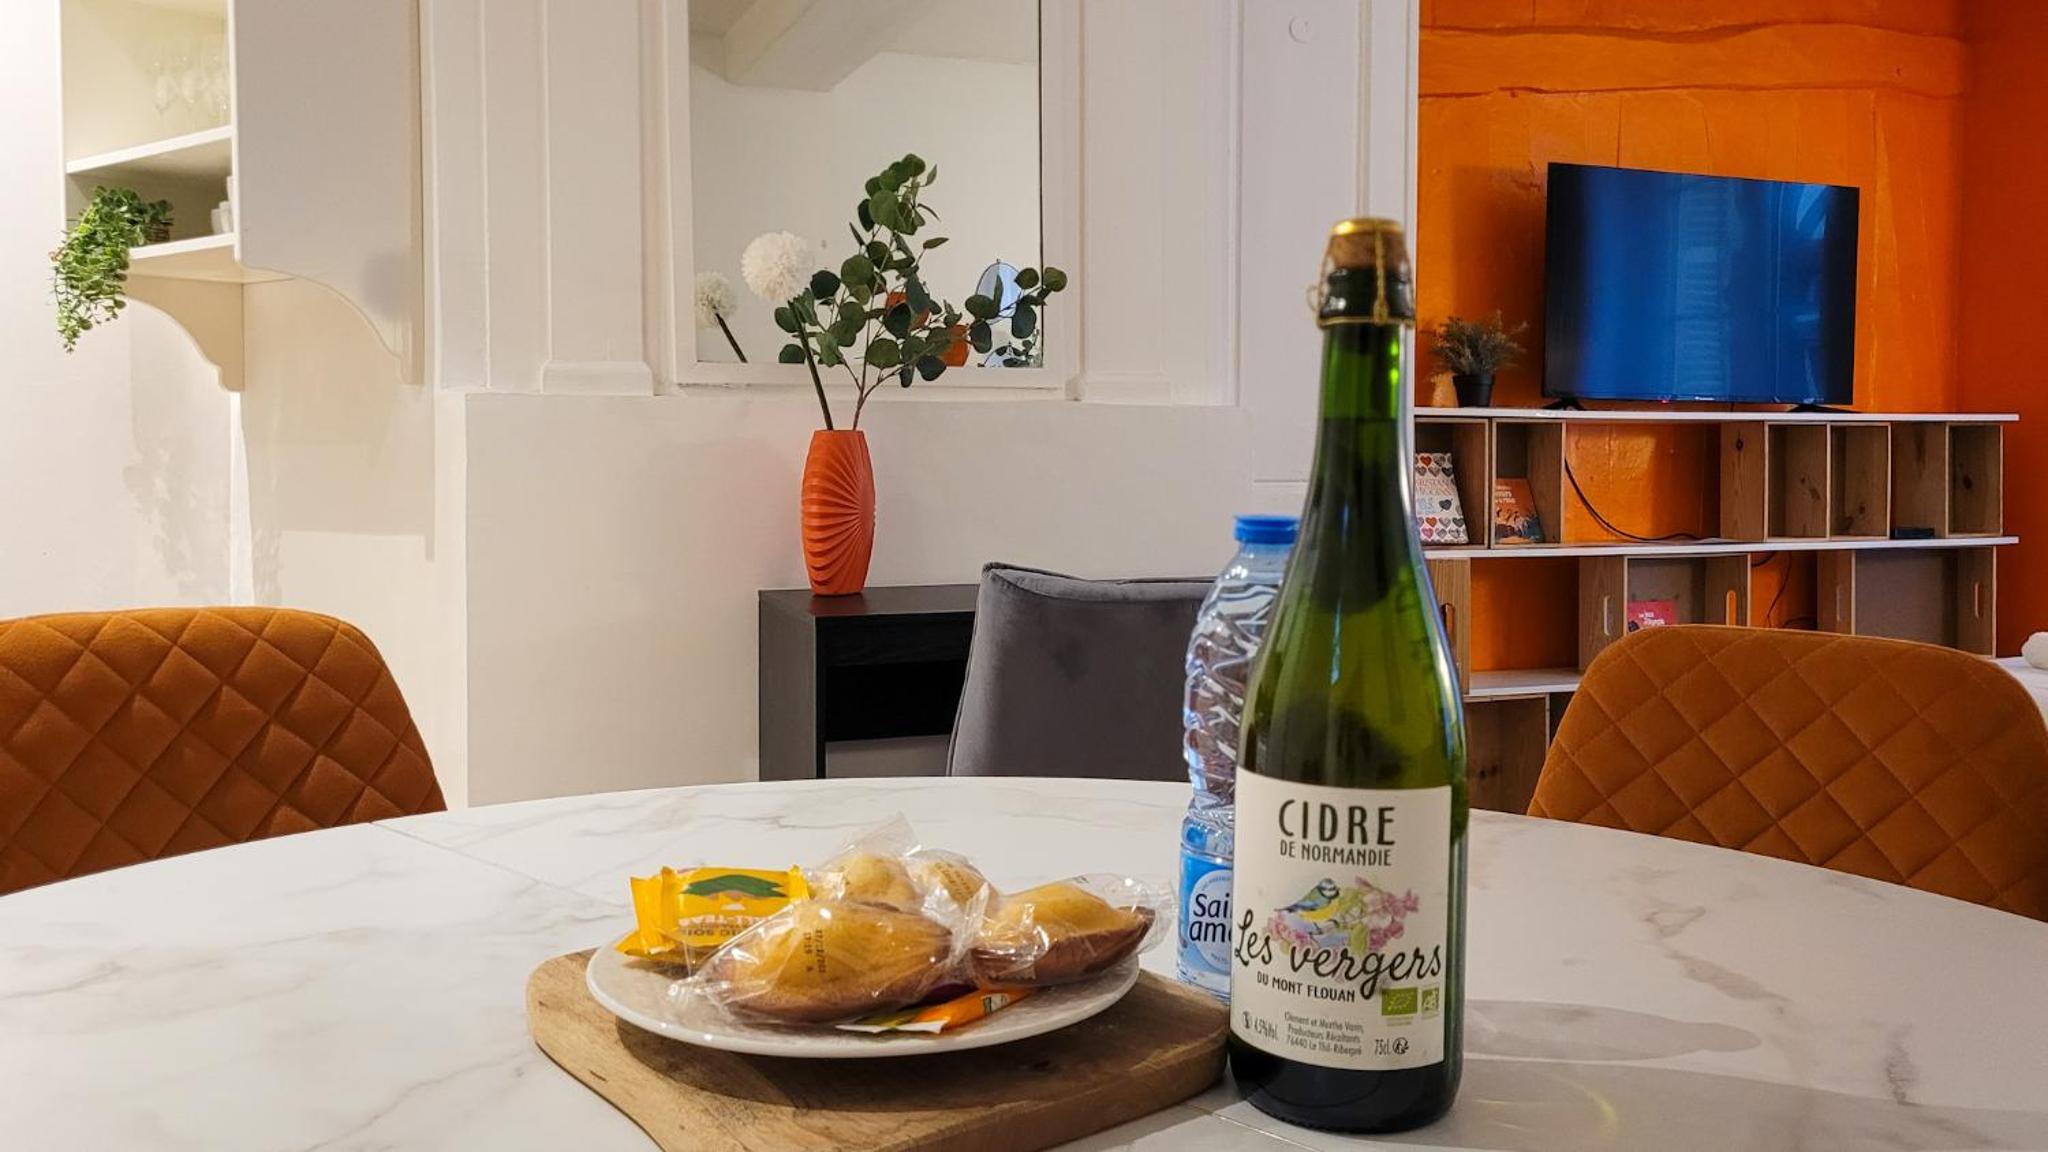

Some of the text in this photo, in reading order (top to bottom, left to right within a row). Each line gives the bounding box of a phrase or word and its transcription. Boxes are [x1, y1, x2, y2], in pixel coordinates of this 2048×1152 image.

[1278, 798, 1397, 846] CIDRE
[1279, 839, 1394, 867] DE NORMANDIE
[1193, 893, 1232, 919] Sai
[1190, 920, 1232, 944] am
[1234, 908, 1441, 1001] Les vergers
[1256, 970, 1356, 1003] DU MONT FLOUAN
